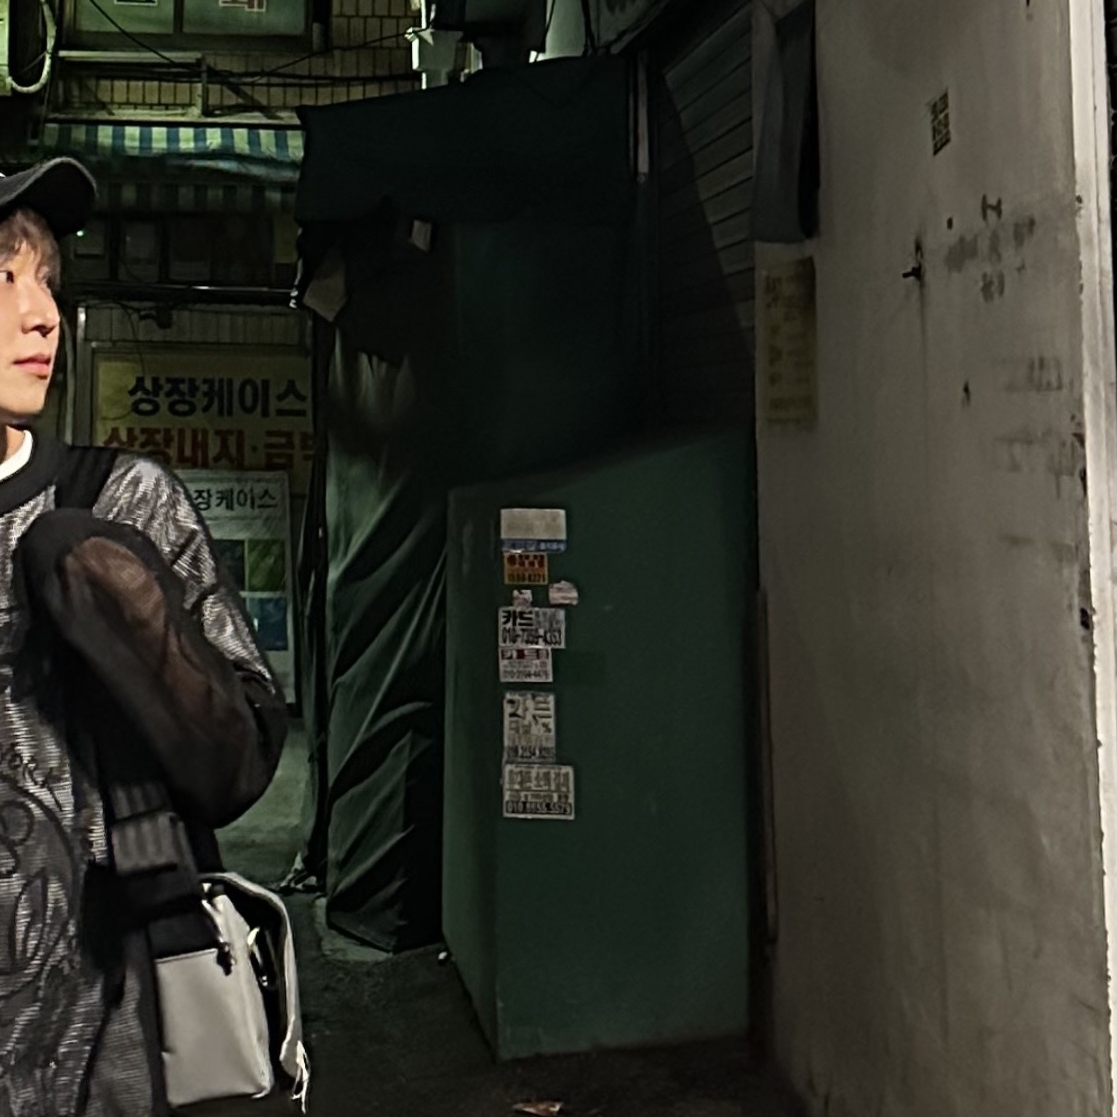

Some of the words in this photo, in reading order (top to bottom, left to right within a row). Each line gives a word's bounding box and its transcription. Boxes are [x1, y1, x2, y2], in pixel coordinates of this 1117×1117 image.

[128, 376, 308, 417] 상장케이스
[103, 427, 313, 469] 장내지·금
[502, 610, 534, 627] 카드
